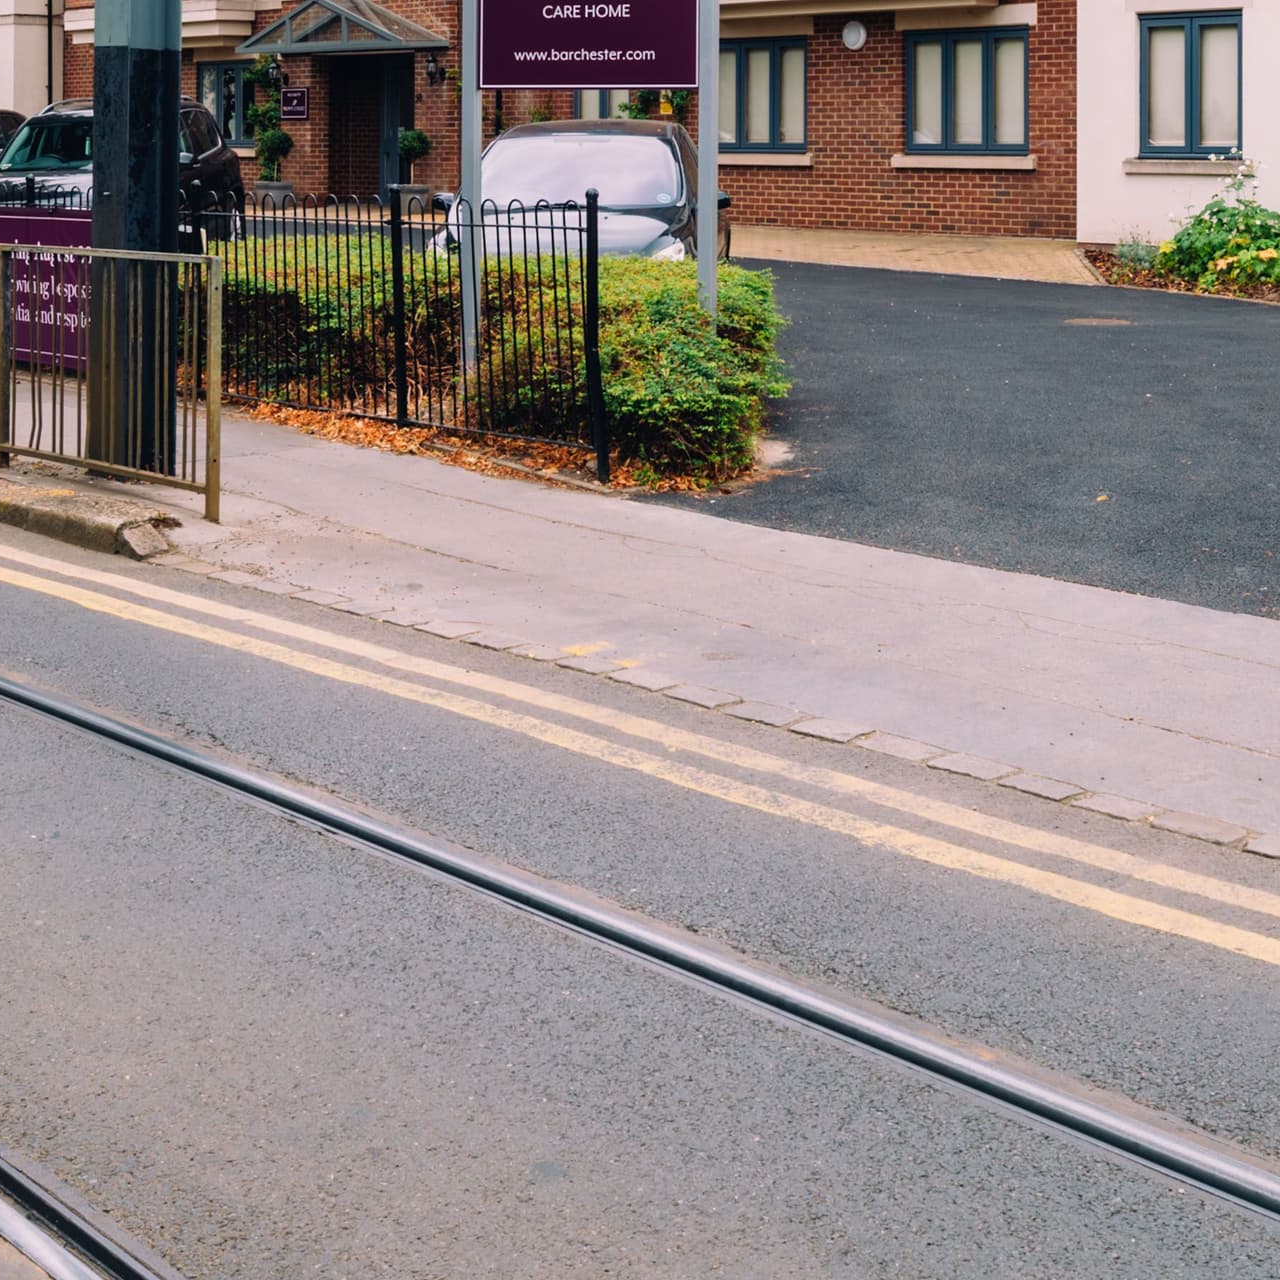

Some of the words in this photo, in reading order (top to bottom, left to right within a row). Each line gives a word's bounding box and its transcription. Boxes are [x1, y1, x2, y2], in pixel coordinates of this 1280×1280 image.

[542, 4, 581, 19] CARE
[584, 3, 631, 18] HOME
[513, 48, 656, 61] www.barchester.com
